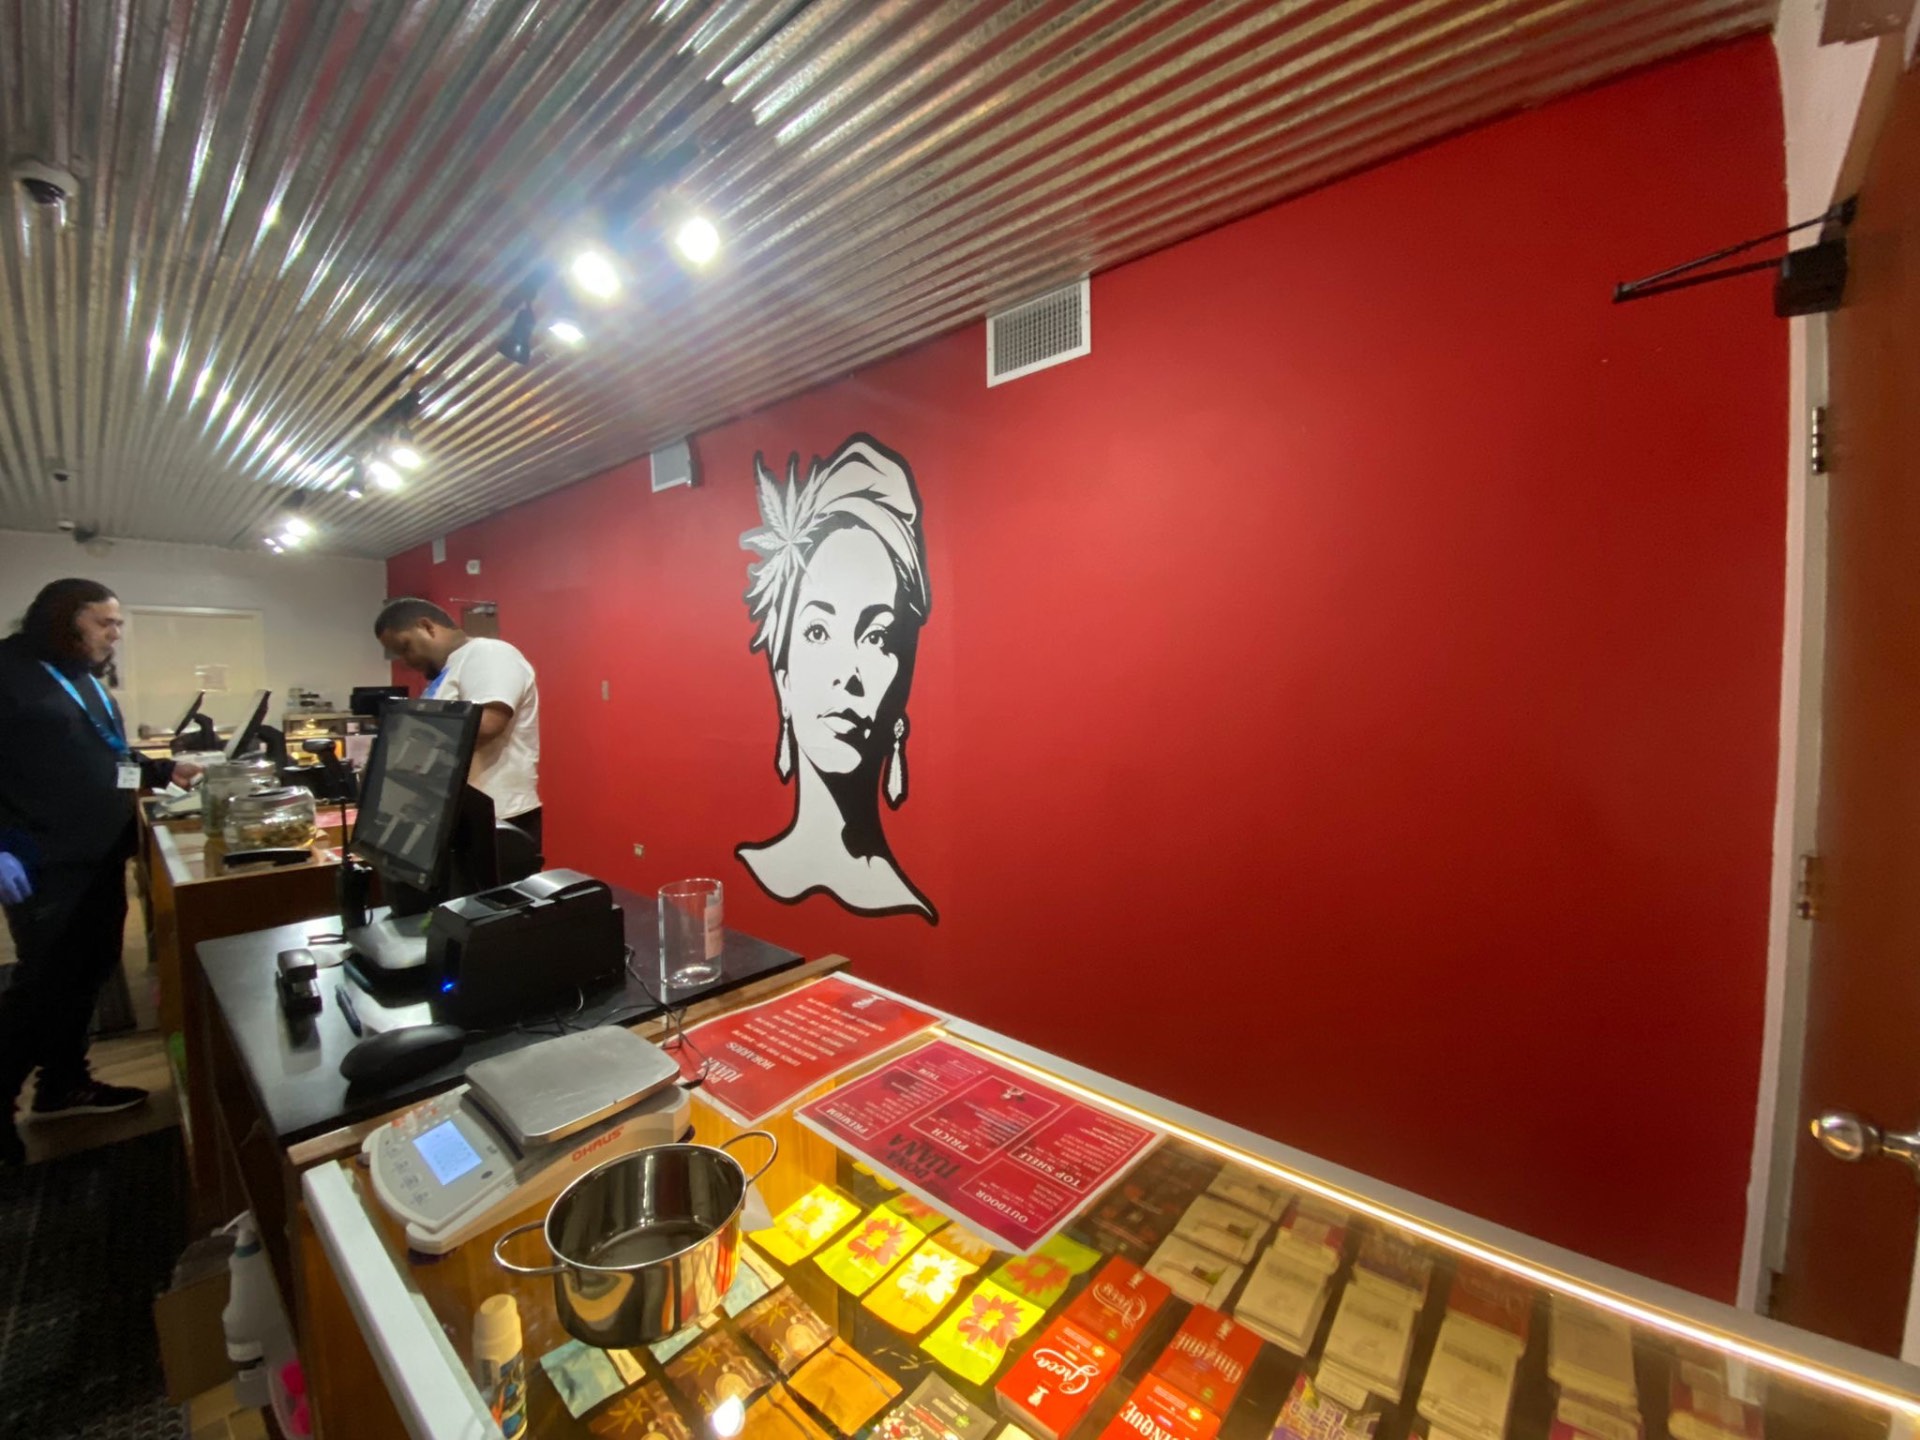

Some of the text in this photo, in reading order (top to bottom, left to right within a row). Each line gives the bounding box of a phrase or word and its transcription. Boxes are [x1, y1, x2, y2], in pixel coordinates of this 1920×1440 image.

[824, 1107, 869, 1134] PREMIUM
[572, 1126, 624, 1162] OHAUS
[887, 1134, 961, 1178] JUANA
[929, 1127, 970, 1151] PRICH
[1016, 1150, 1082, 1187] TOP SHELF
[973, 1188, 1030, 1223] OUTDOOR
